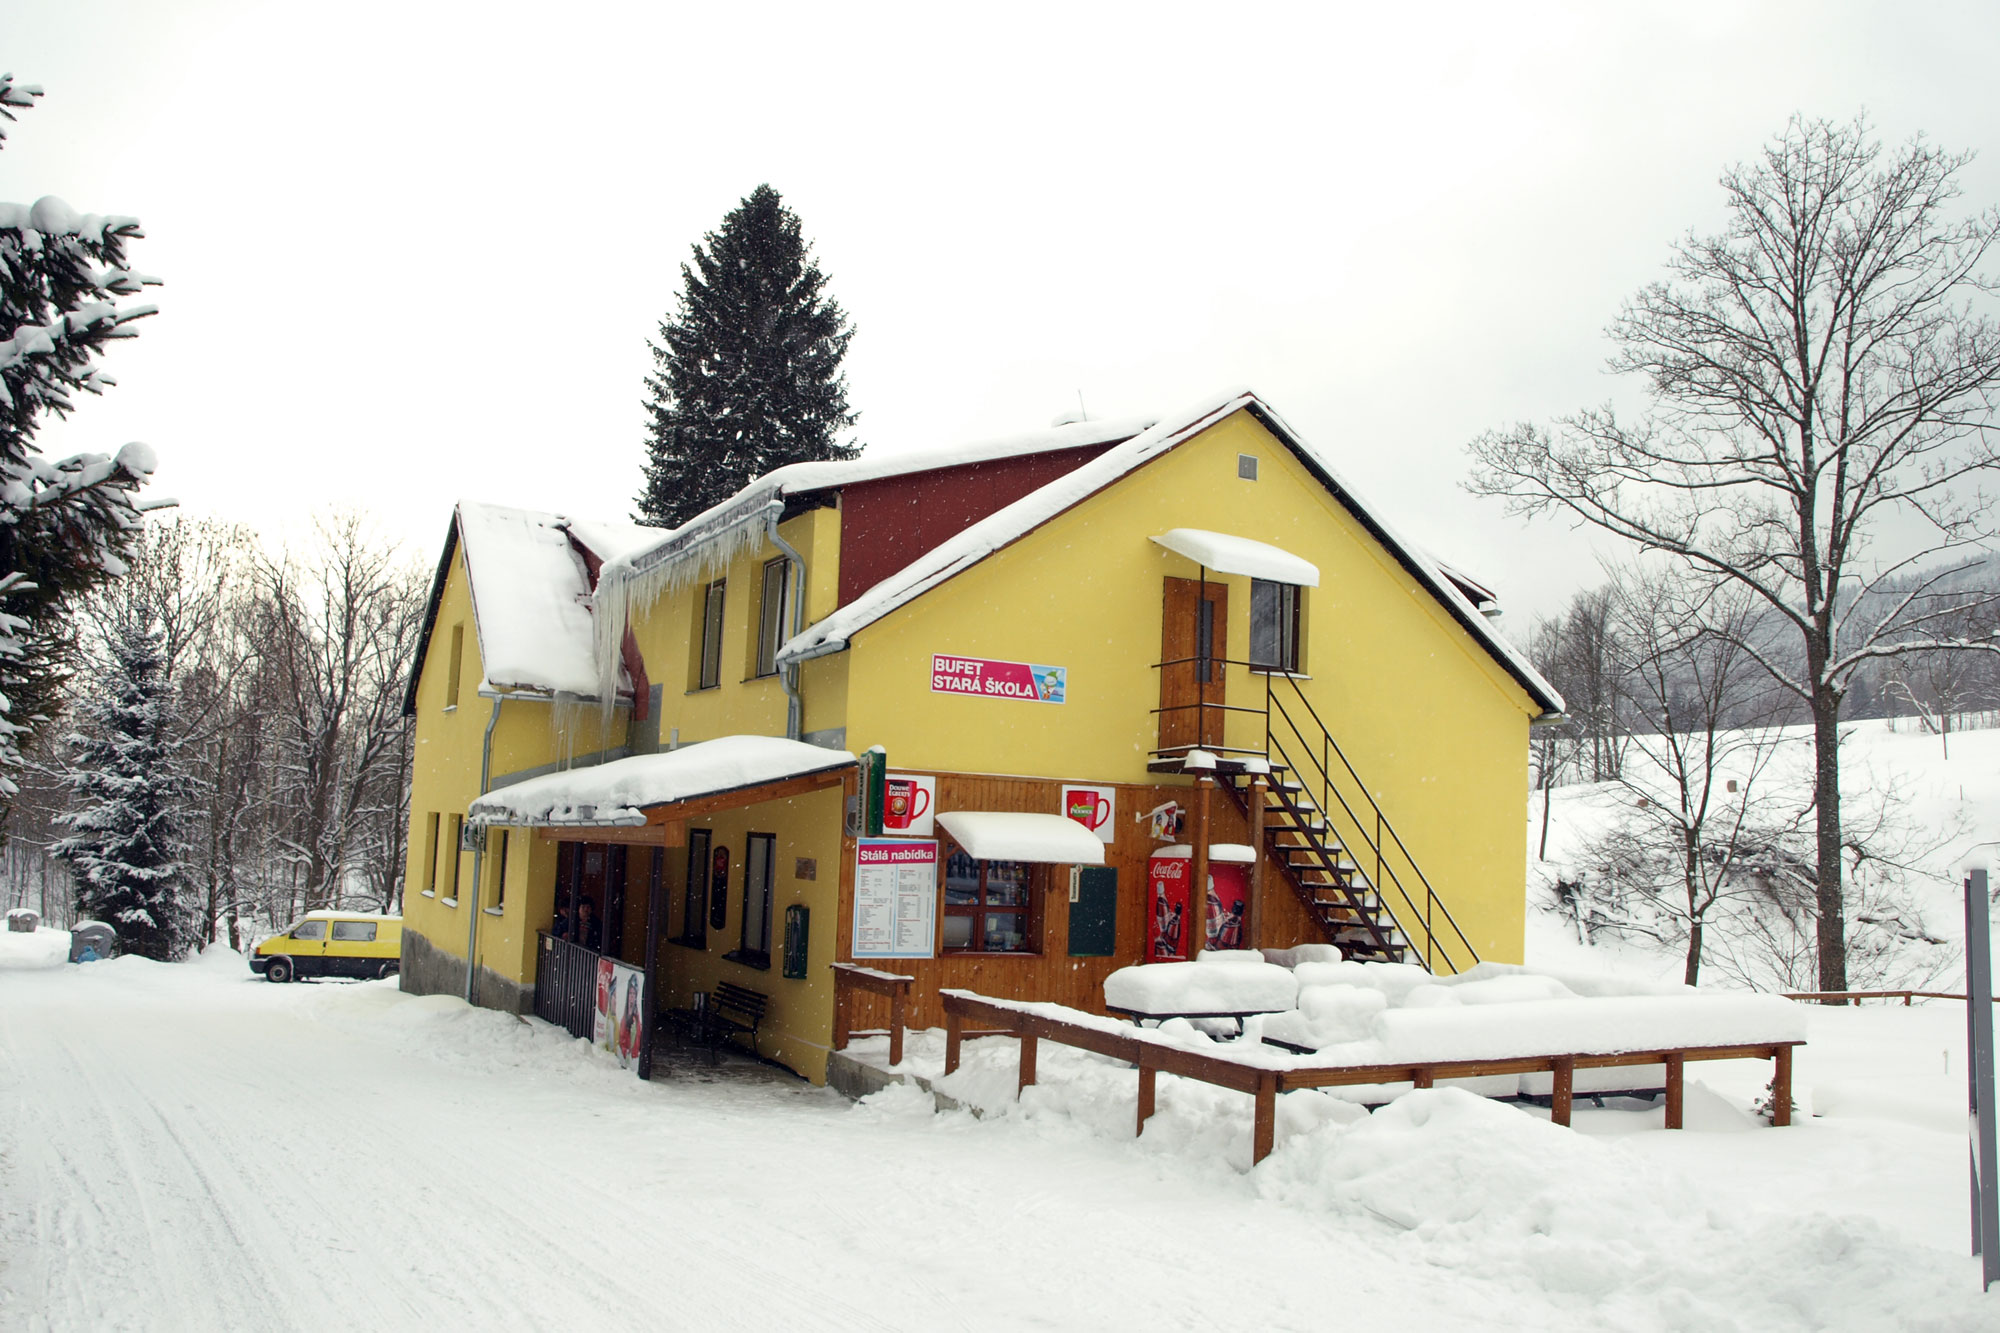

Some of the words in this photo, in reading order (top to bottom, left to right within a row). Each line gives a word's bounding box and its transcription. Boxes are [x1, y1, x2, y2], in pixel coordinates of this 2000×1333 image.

[934, 658, 983, 676] BUFET
[933, 675, 982, 692] STARÁ
[985, 677, 1034, 697] ŠKOLA
[860, 850, 889, 861] Stálá
[891, 849, 934, 860] nabídka
